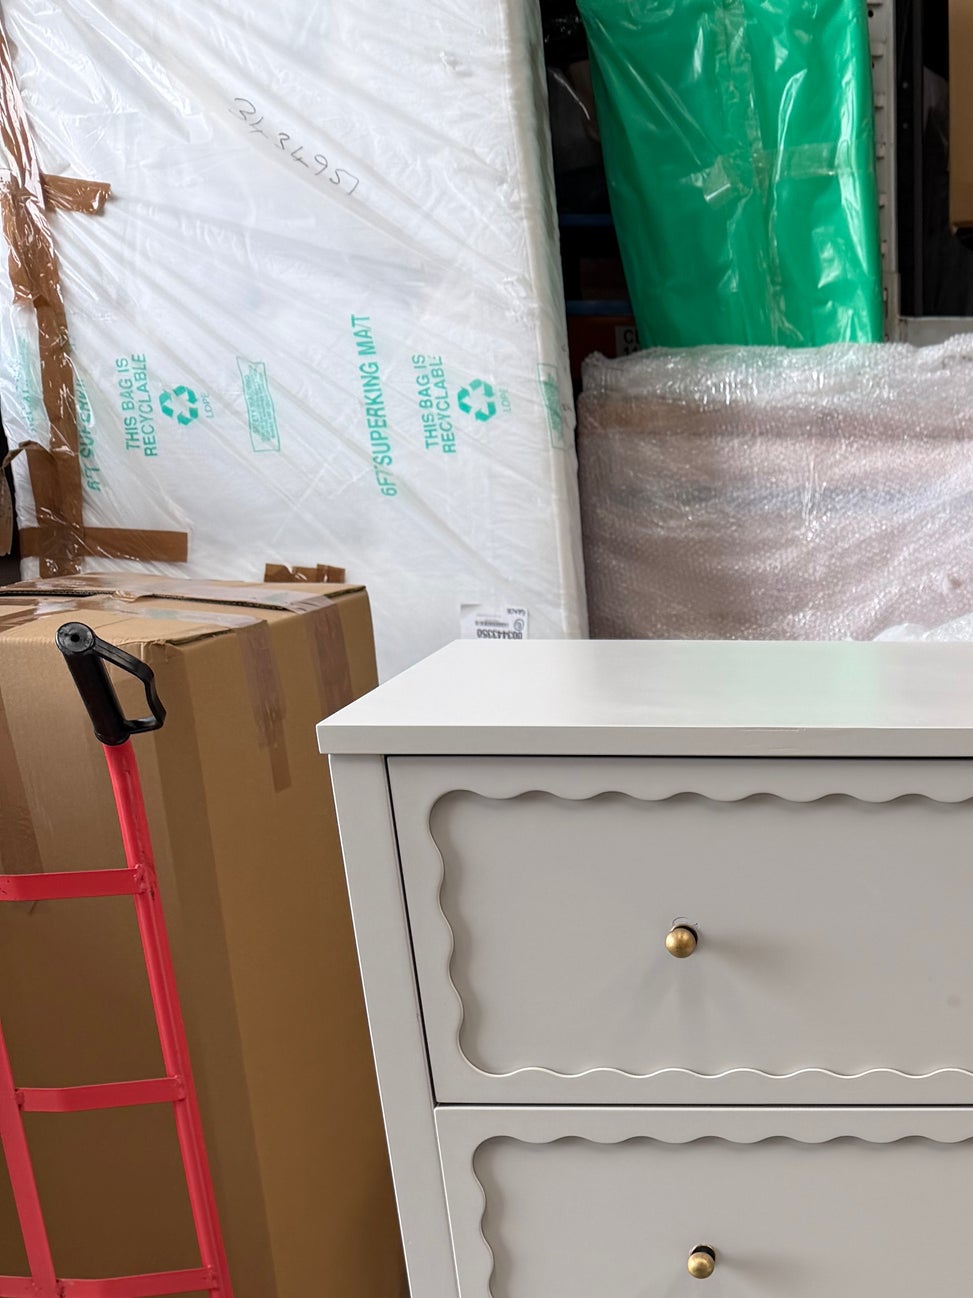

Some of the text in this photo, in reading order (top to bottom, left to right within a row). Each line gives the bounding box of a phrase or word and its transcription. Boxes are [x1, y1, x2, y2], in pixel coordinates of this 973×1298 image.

[115, 357, 142, 450] THIS BAG IS
[131, 353, 159, 458] RECYCLABLE
[411, 353, 440, 450] THIS BAG IS
